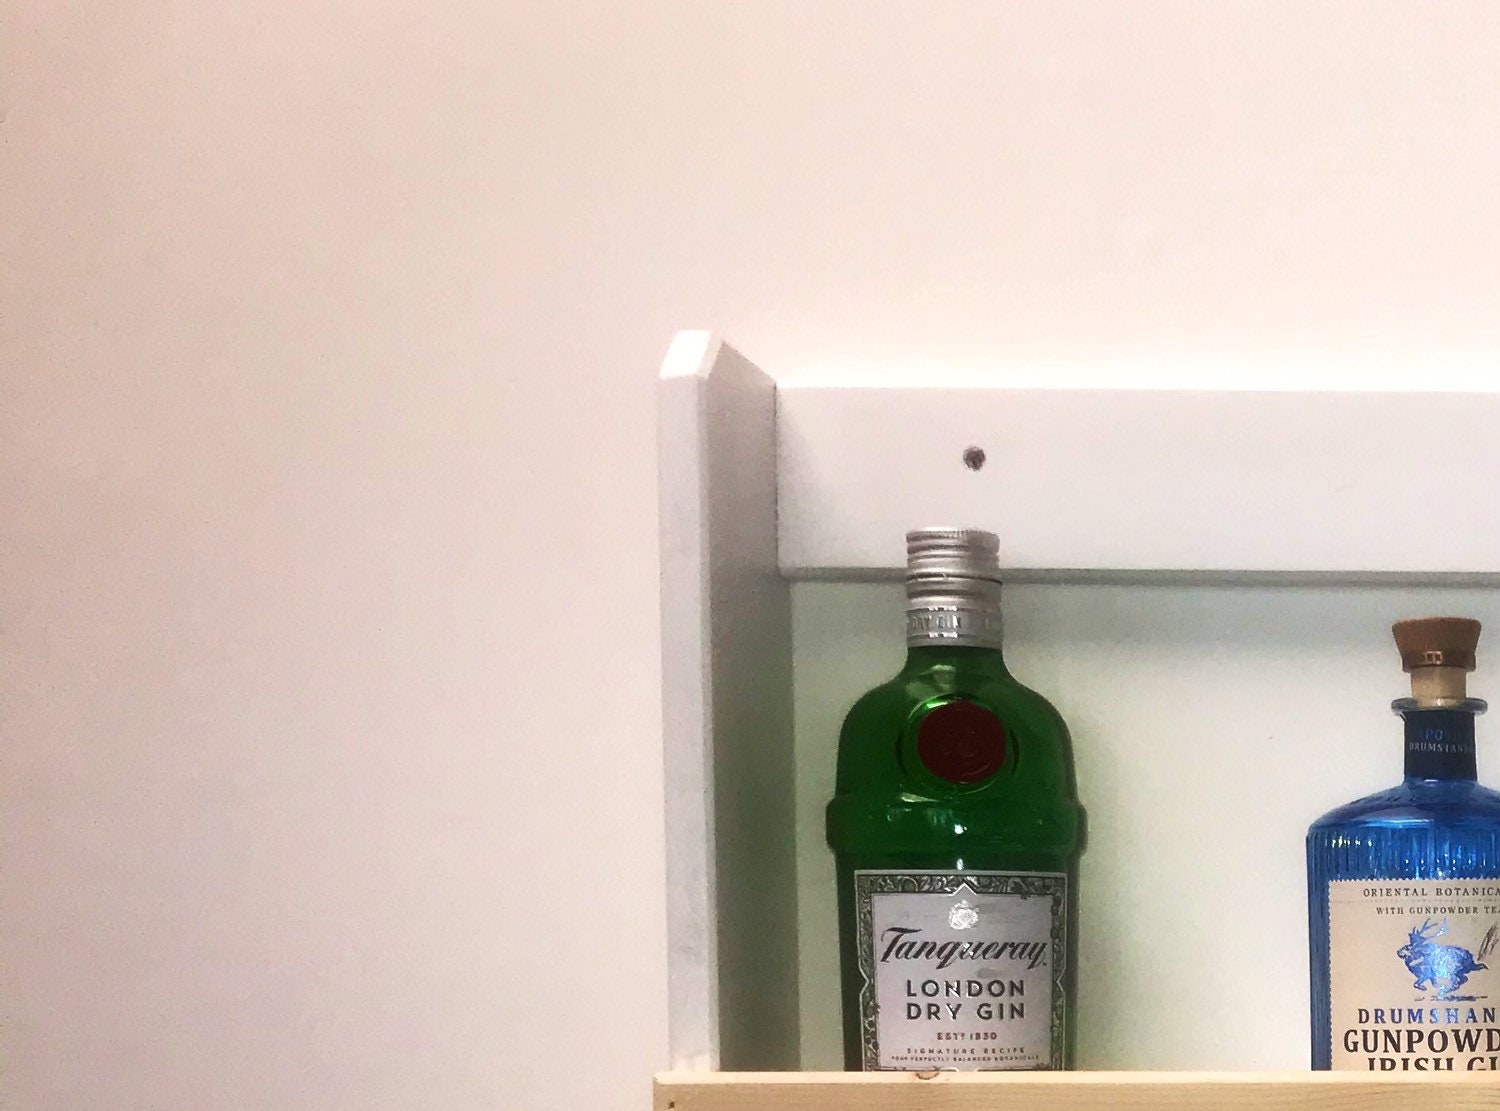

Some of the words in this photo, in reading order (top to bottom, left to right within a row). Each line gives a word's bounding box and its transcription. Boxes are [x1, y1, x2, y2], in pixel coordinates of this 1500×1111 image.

[1363, 887, 1428, 897] ORIENTAL
[1376, 906, 1404, 915] WITH
[1409, 906, 1479, 915] GUNPOWDER
[906, 979, 1025, 998] LONDON
[906, 1002, 962, 1021] DRY
[976, 1002, 1025, 1021] GIN
[907, 1047, 976, 1055] SIGNATURE
[983, 1047, 1025, 1055] RECIPE
